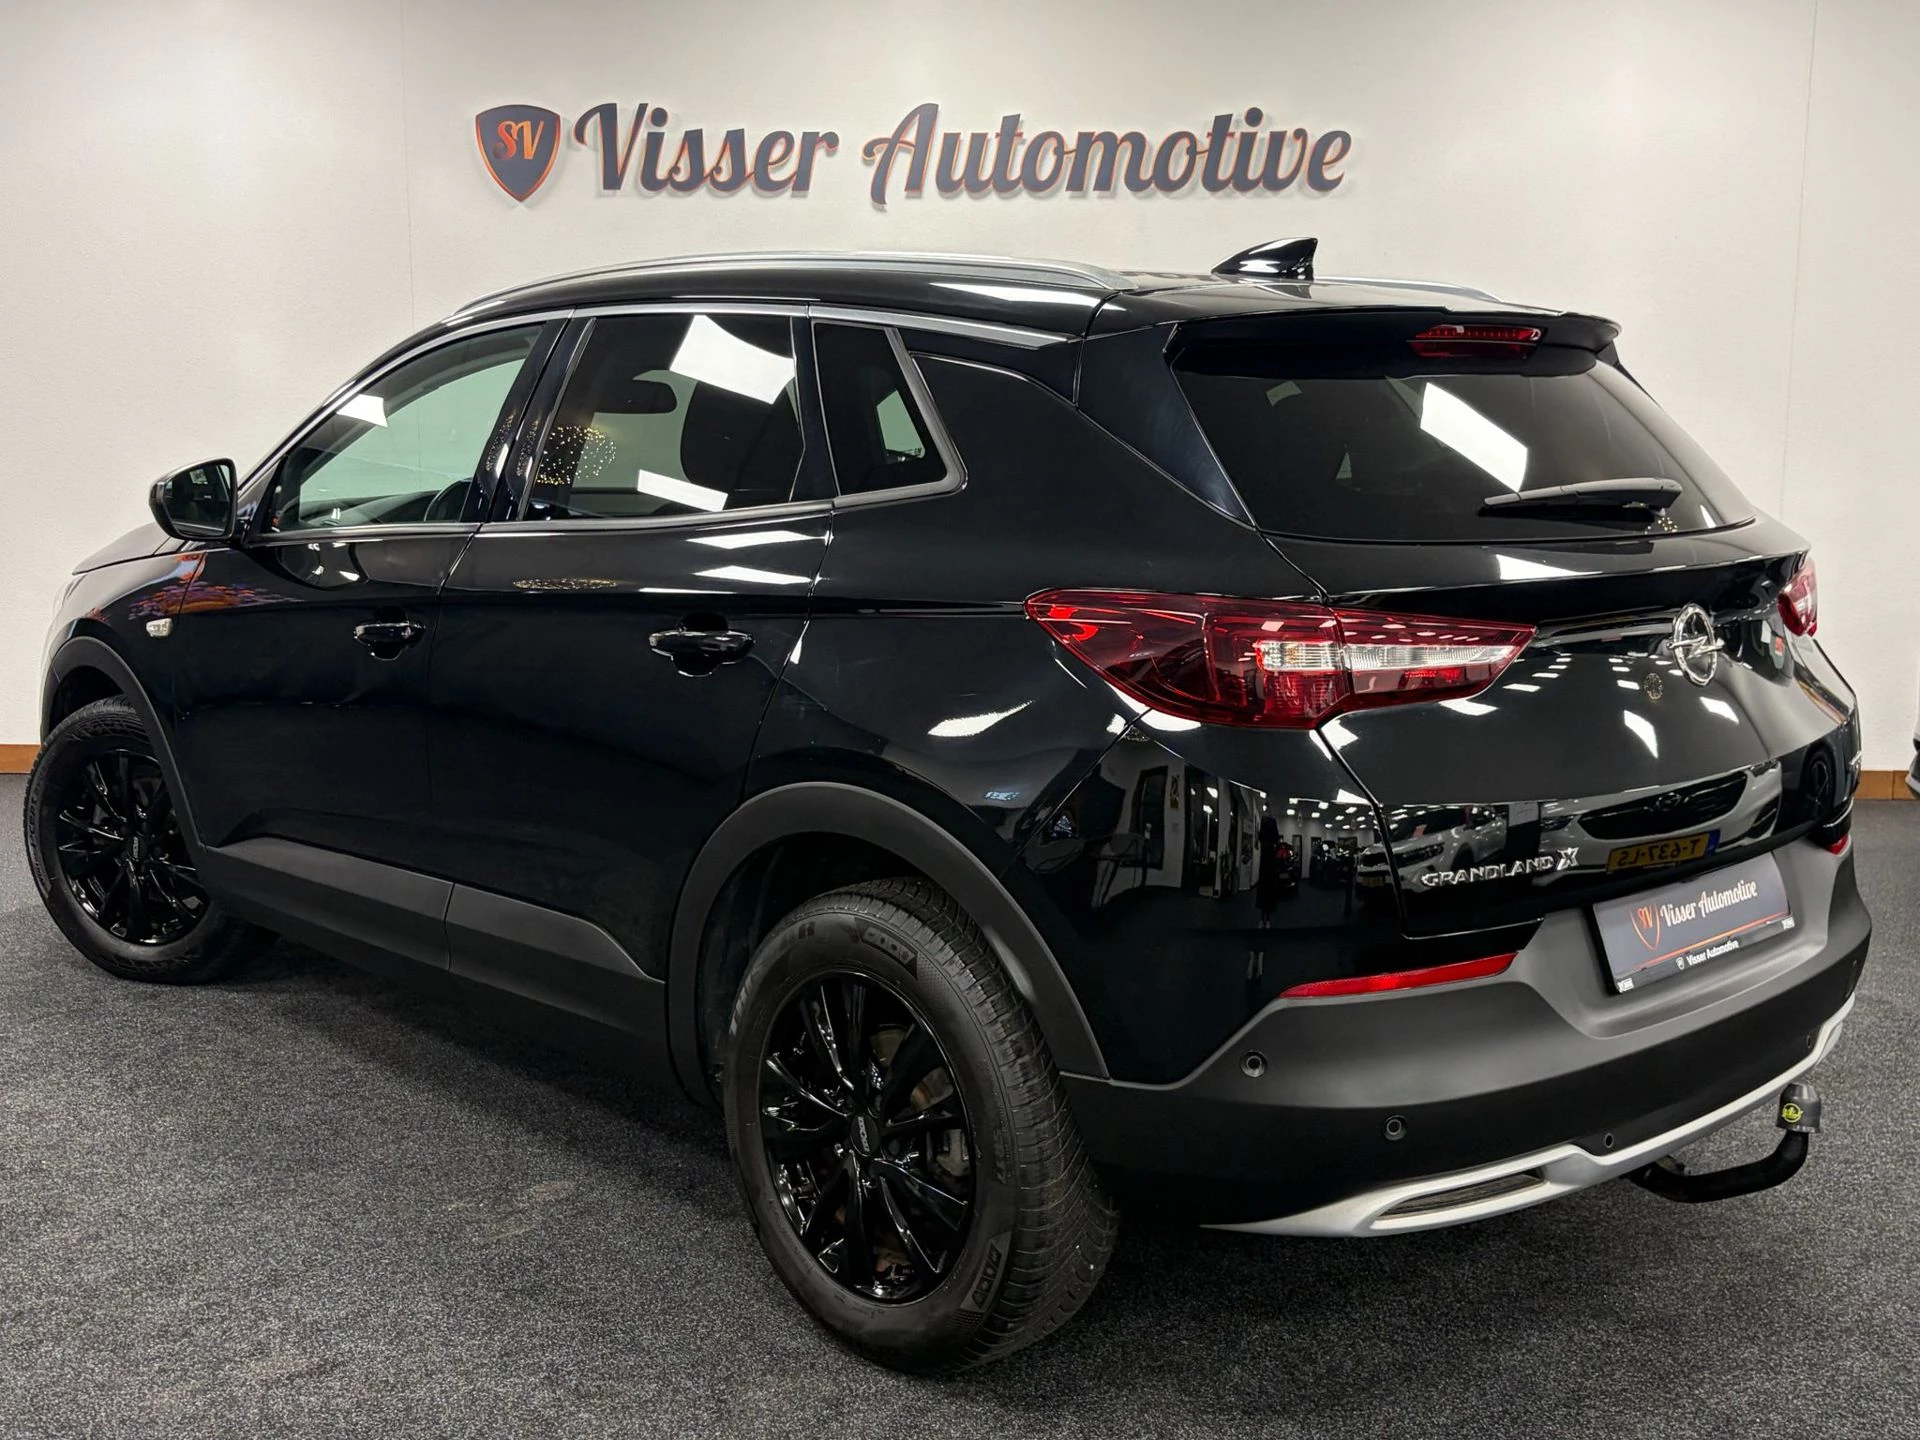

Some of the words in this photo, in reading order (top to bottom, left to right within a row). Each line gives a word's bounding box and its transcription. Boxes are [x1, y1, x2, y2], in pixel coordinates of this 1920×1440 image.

[496, 119, 545, 161] SV
[573, 102, 840, 192] Visser
[861, 102, 1353, 205] Automotive
[1421, 856, 1553, 886] GRANDLAND
[1557, 847, 1579, 871] X
[1660, 903, 1696, 927] Visser
[1697, 879, 1758, 918] Automotive
[1686, 951, 1707, 966] Visser
[1706, 938, 1740, 959] Automotive
